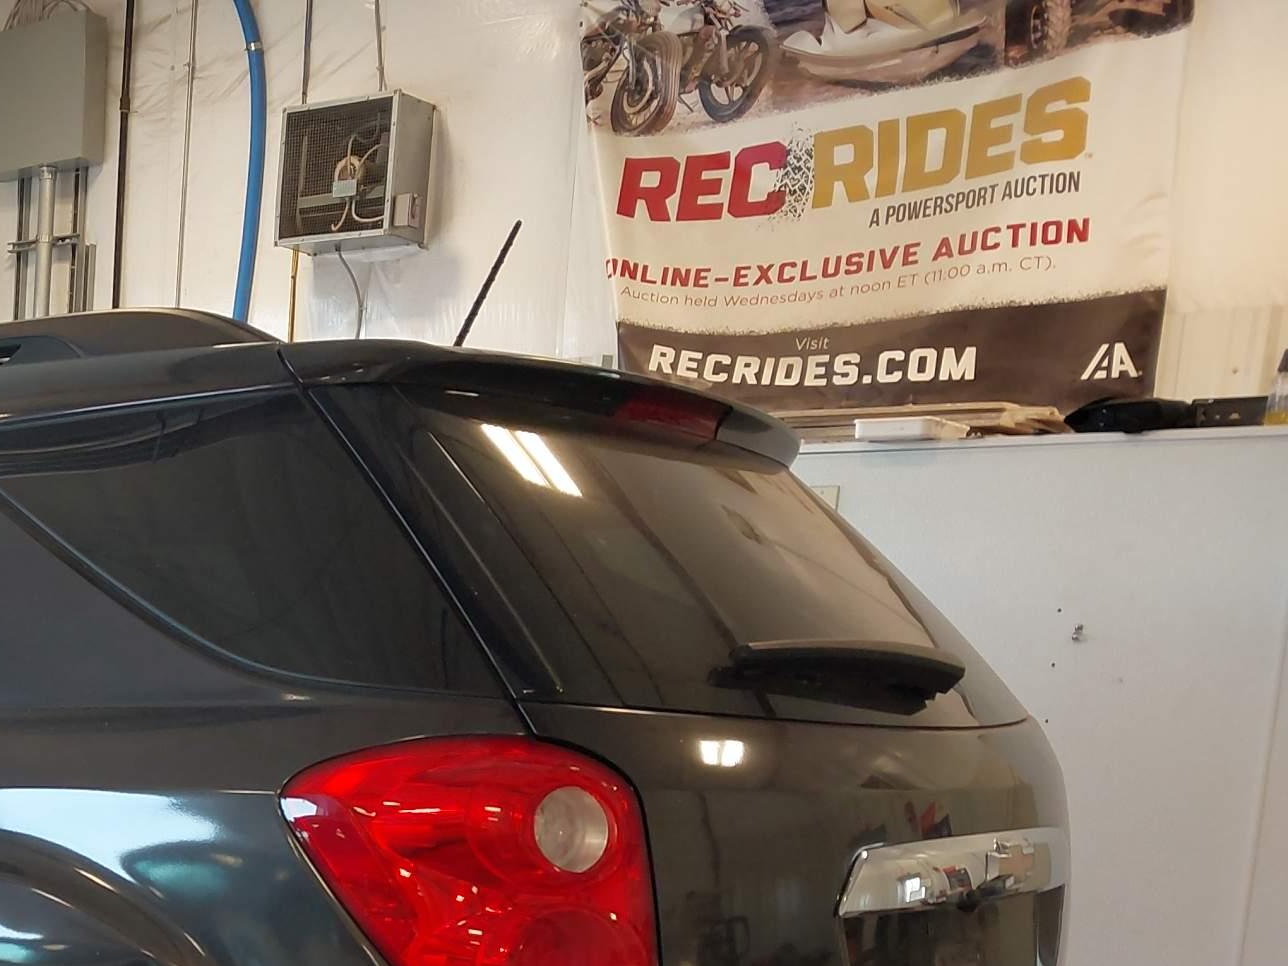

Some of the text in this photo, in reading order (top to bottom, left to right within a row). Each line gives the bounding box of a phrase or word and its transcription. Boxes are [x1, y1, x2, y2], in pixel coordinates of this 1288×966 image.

[616, 76, 1091, 222] REC RIDES
[869, 171, 1081, 229] A POWERSPORT AUCTION
[605, 217, 1091, 288] ONLINE-EXCLUSIVE AUCTION
[620, 255, 1056, 308] Auction held Wednesdays at noon ET (11:00 a.m. CT).
[648, 343, 977, 387] RECRIDES.COM
[795, 336, 830, 351] Visit
